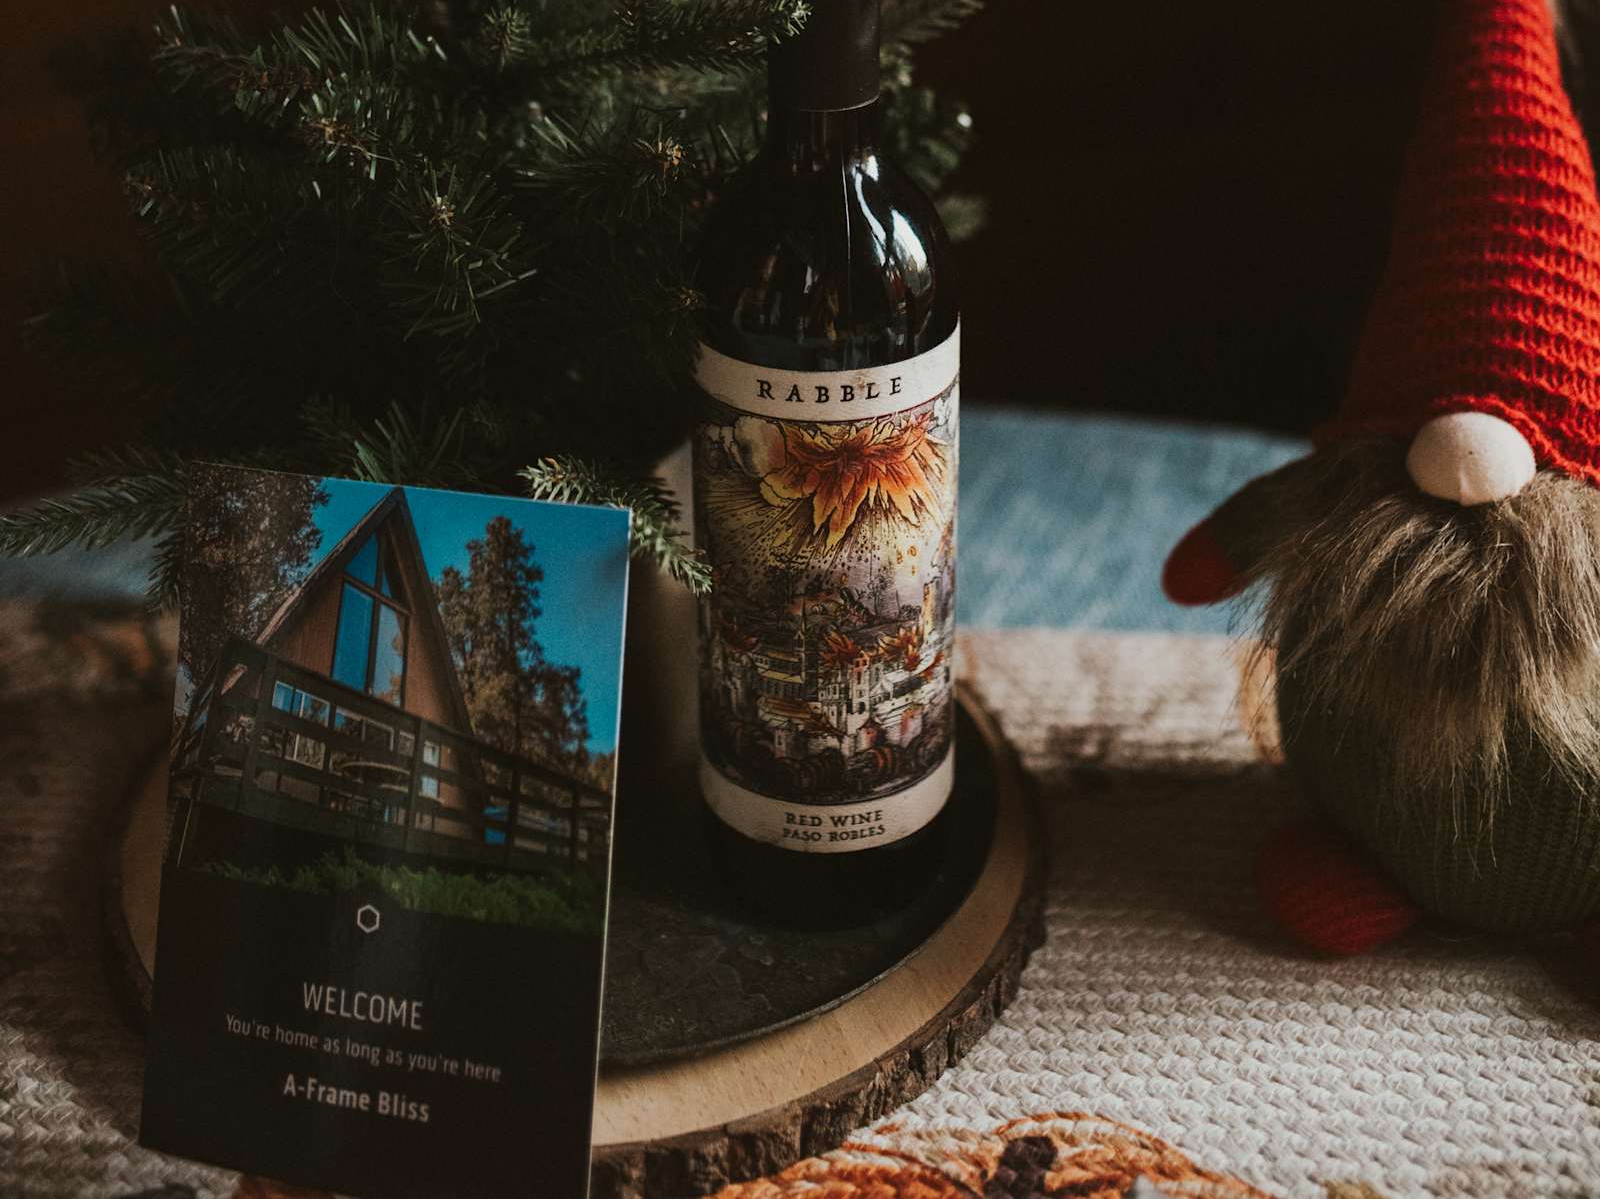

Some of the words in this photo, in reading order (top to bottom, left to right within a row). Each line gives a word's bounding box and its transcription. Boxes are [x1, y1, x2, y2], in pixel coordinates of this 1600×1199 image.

[757, 376, 902, 403] RABBLE
[783, 826, 822, 842] PASO
[829, 824, 886, 843] ROBLES
[785, 811, 822, 827] RED
[830, 809, 883, 827] WINE
[303, 981, 424, 1031] WELCOME
[226, 1013, 271, 1041] You're
[275, 1022, 318, 1050] home
[322, 1037, 340, 1055] as
[345, 1037, 381, 1067] long
[386, 1048, 403, 1066] as
[408, 1050, 459, 1076] you're
[464, 1058, 501, 1083] here
[283, 1073, 370, 1113] A-Frame
[378, 1091, 431, 1123] Bliss
